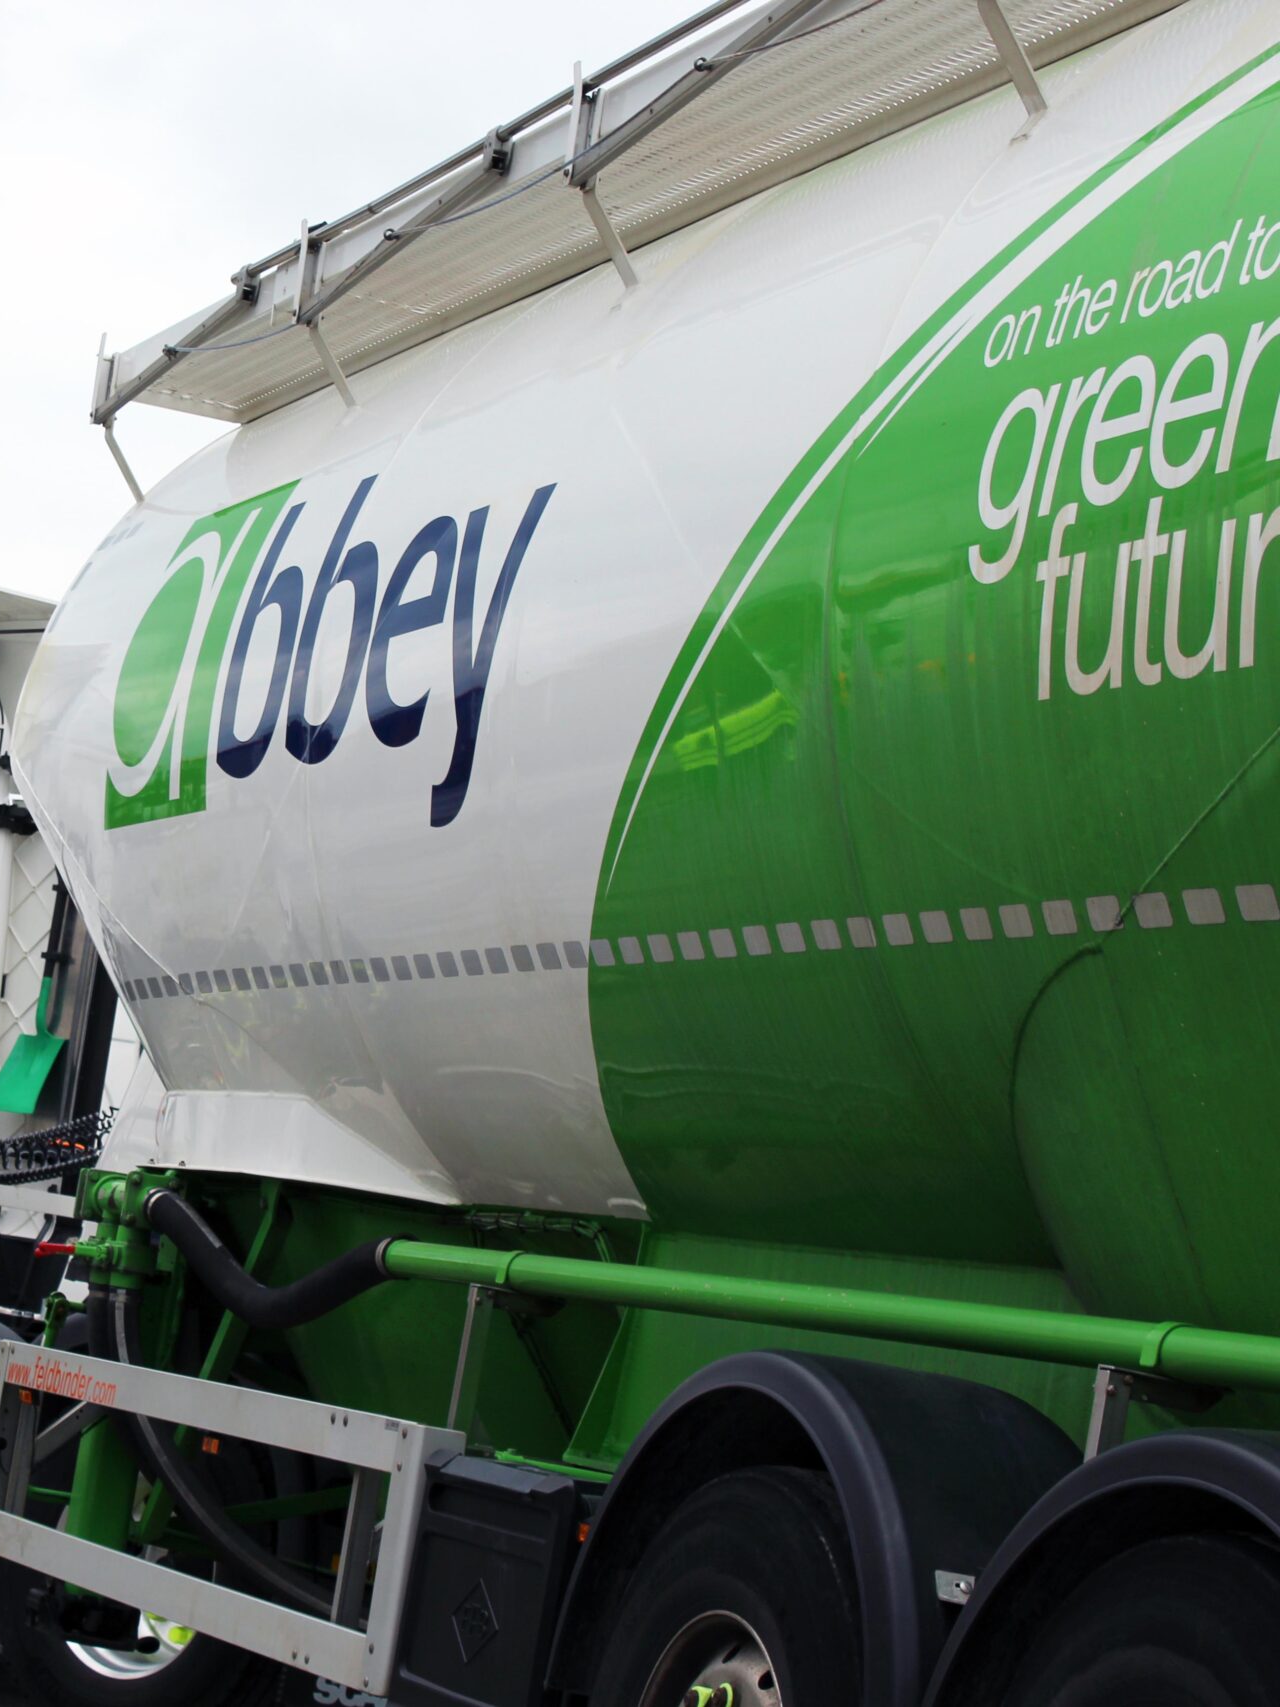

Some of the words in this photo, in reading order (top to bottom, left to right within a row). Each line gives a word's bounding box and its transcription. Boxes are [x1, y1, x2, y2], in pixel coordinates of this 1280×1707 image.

[983, 304, 1042, 369] on
[1044, 274, 1118, 349] the
[1120, 218, 1244, 325] road
[1238, 214, 1280, 286] to
[968, 316, 1280, 586] green
[104, 473, 558, 830] abbey
[1035, 495, 1280, 702] futur
[6, 1355, 118, 1405] www.feldbinder.com
